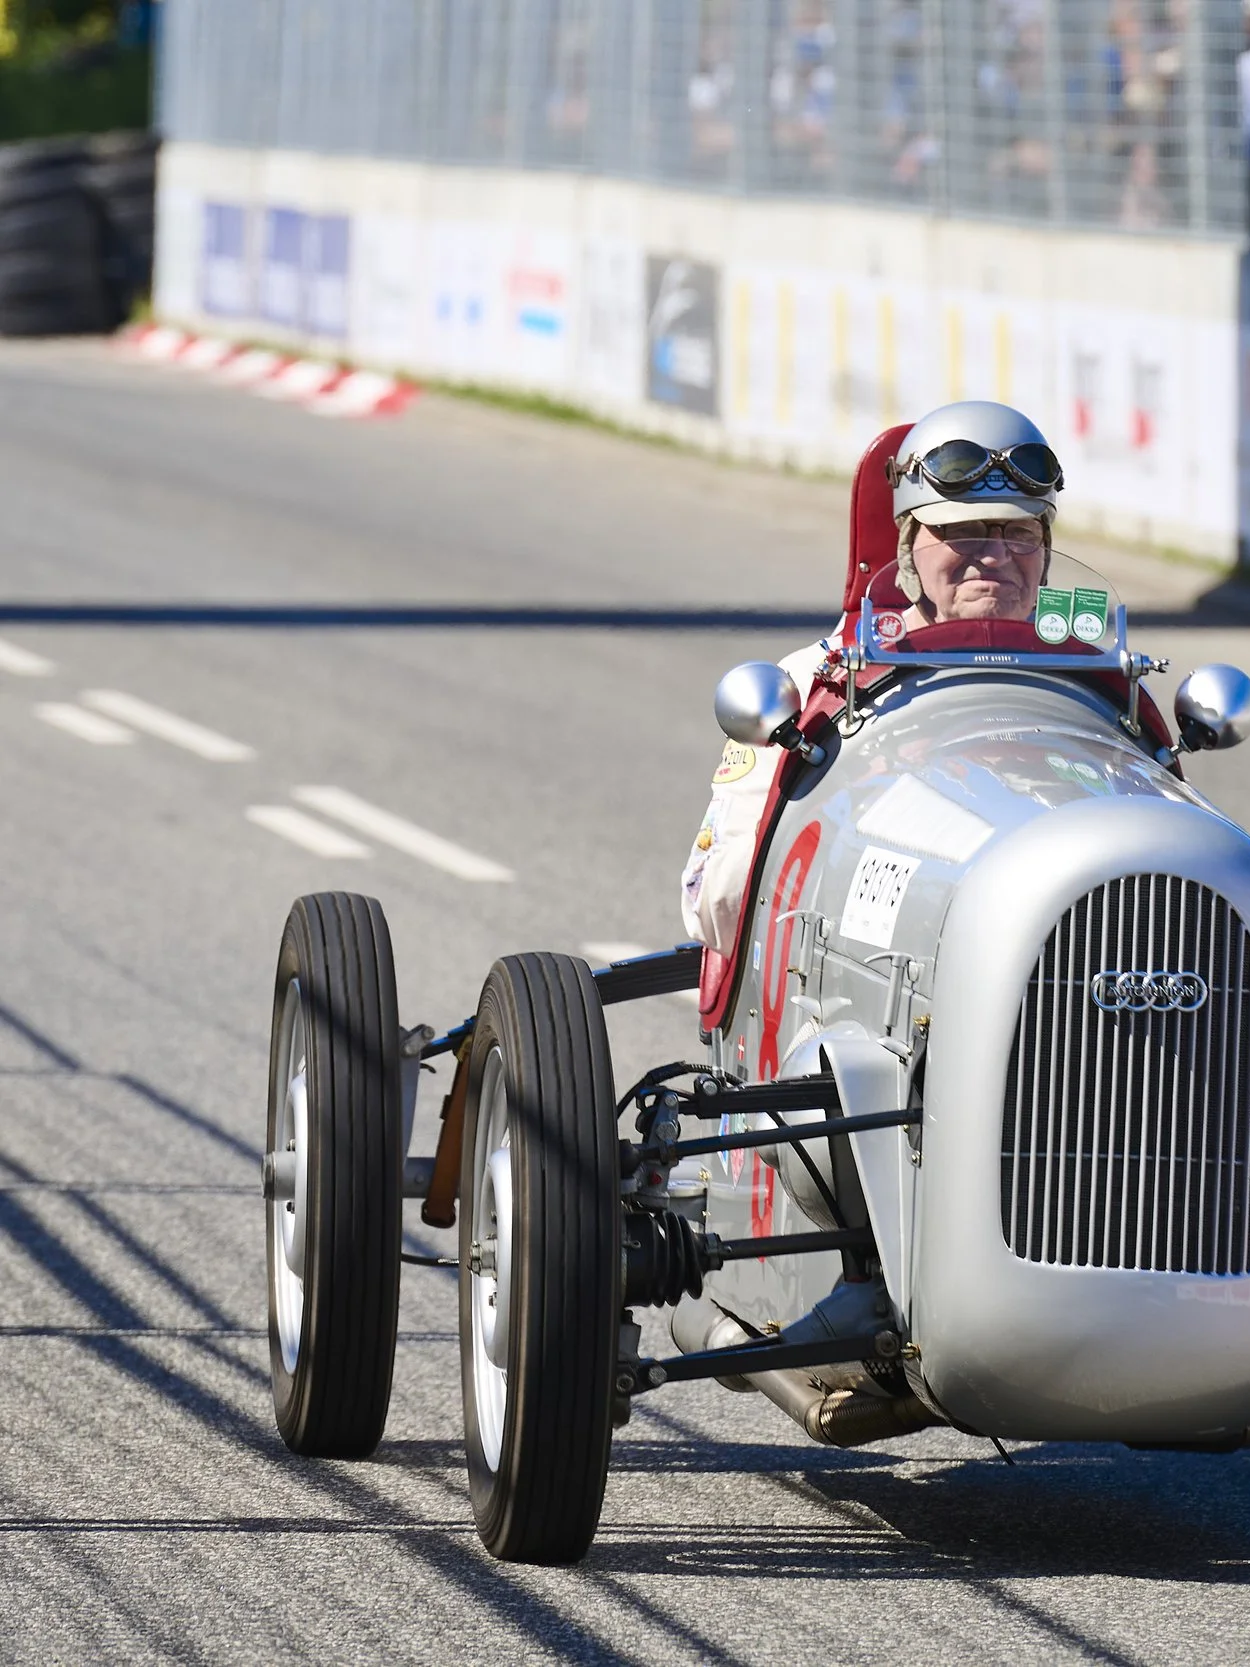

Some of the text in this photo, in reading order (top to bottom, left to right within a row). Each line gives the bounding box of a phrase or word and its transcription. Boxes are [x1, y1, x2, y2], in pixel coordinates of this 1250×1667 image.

[1041, 625, 1064, 633] DEKRA
[1076, 625, 1099, 633] DEKRA
[1148, 985, 1195, 997] UNION
